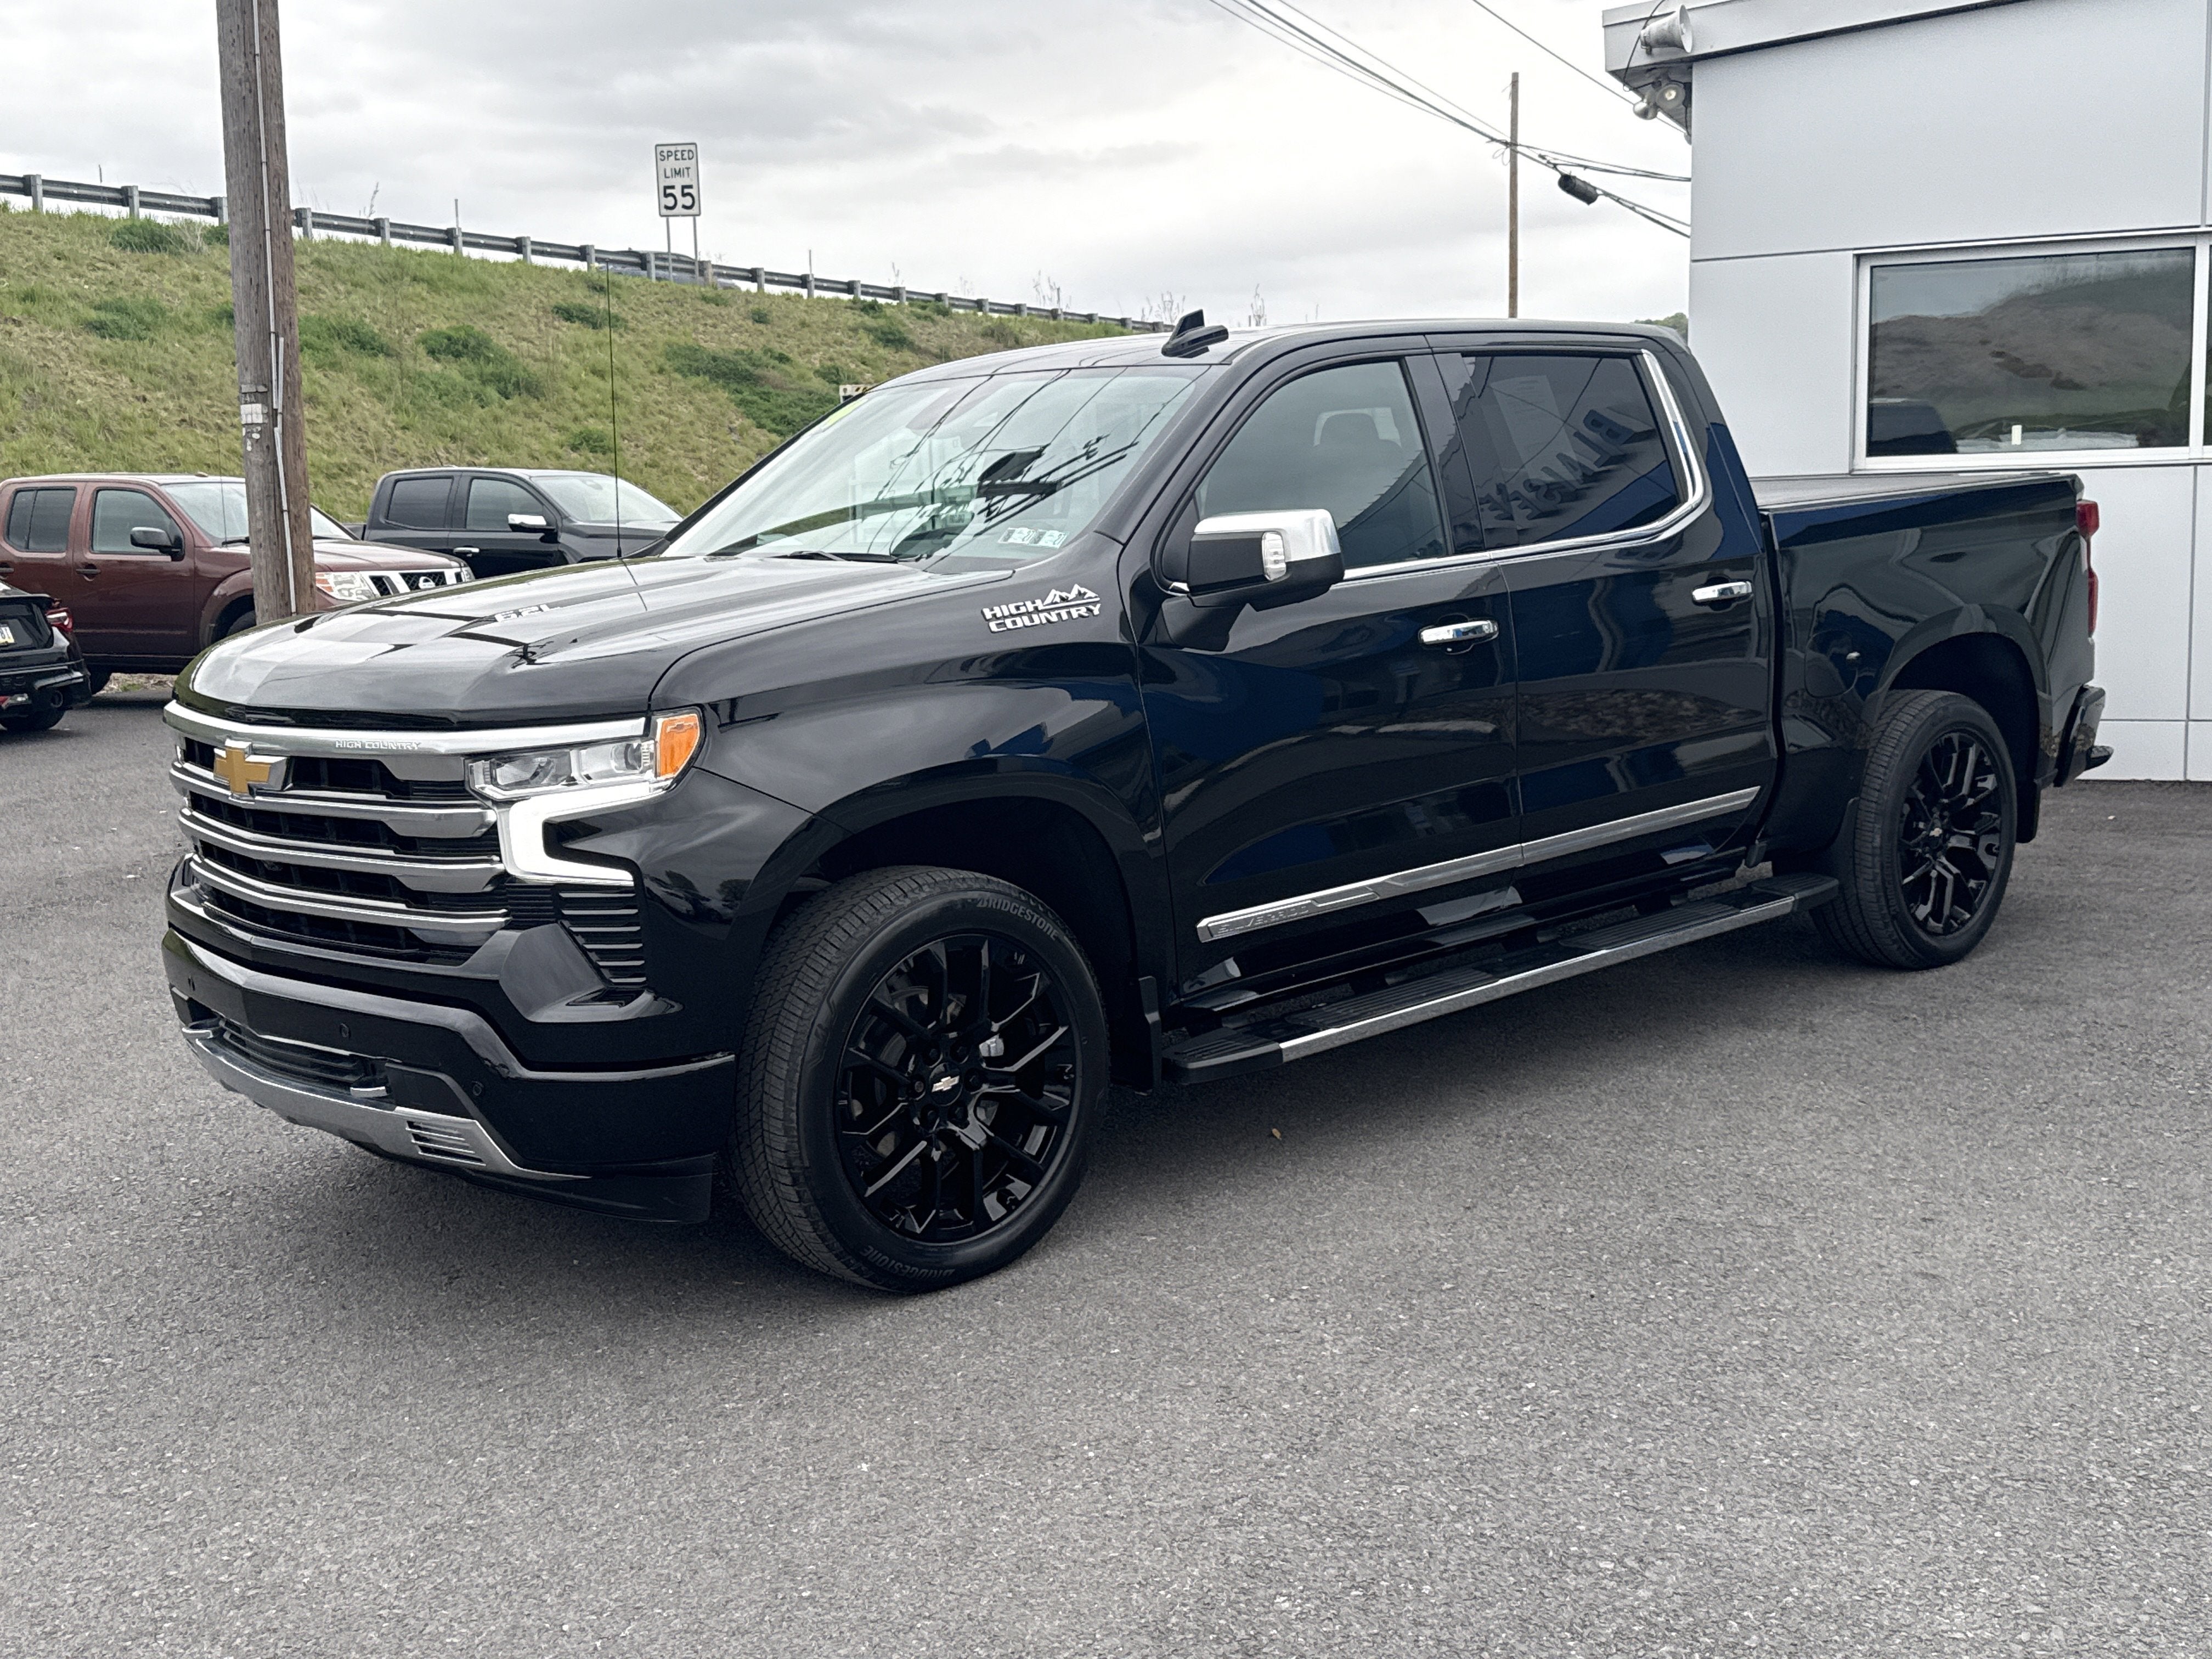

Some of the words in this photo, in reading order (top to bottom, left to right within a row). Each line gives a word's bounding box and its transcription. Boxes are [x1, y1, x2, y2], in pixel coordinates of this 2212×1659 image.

[659, 149, 695, 161] SPEED
[664, 167, 691, 179] LIMIT
[663, 184, 696, 210] 55
[981, 599, 1043, 620] HIGH
[988, 603, 1102, 634] COUNTRY
[335, 741, 362, 749] HIGH
[364, 741, 421, 750] COUNTRY
[977, 896, 1059, 941] BRIDGESTONE
